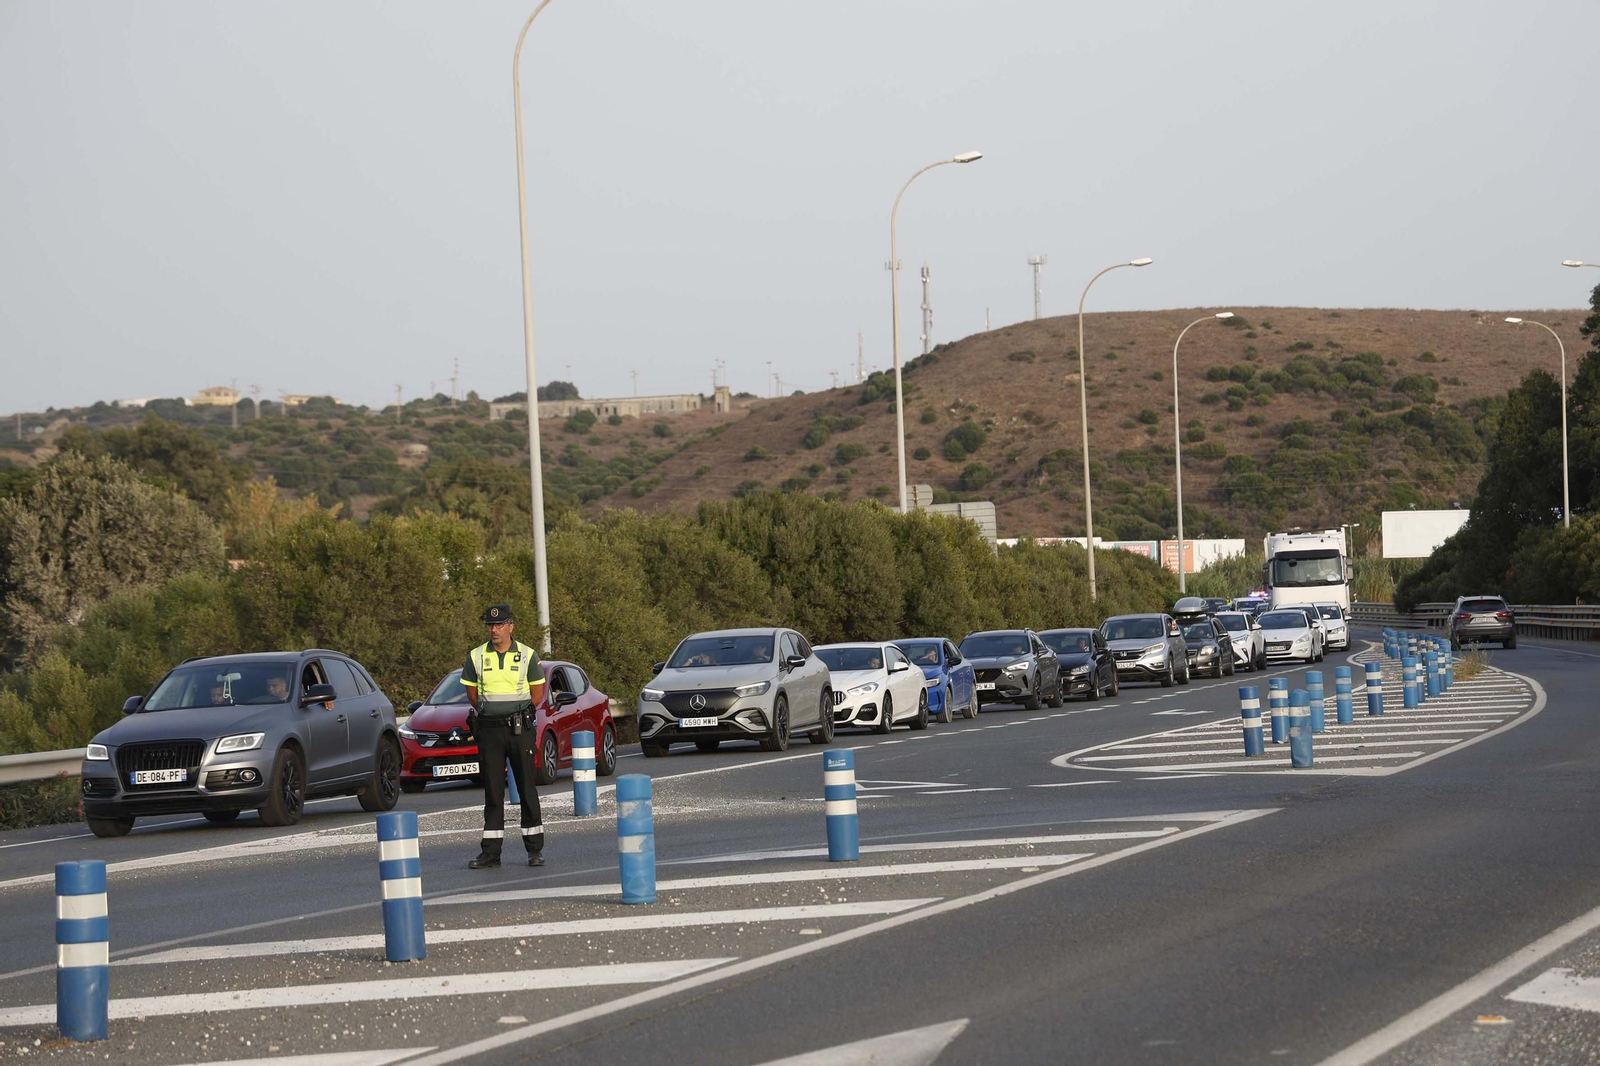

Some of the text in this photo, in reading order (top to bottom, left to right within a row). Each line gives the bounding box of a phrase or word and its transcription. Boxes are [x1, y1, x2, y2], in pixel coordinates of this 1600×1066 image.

[438, 764, 478, 775] 7760 MZS
[136, 770, 180, 783] DE-084-PF
